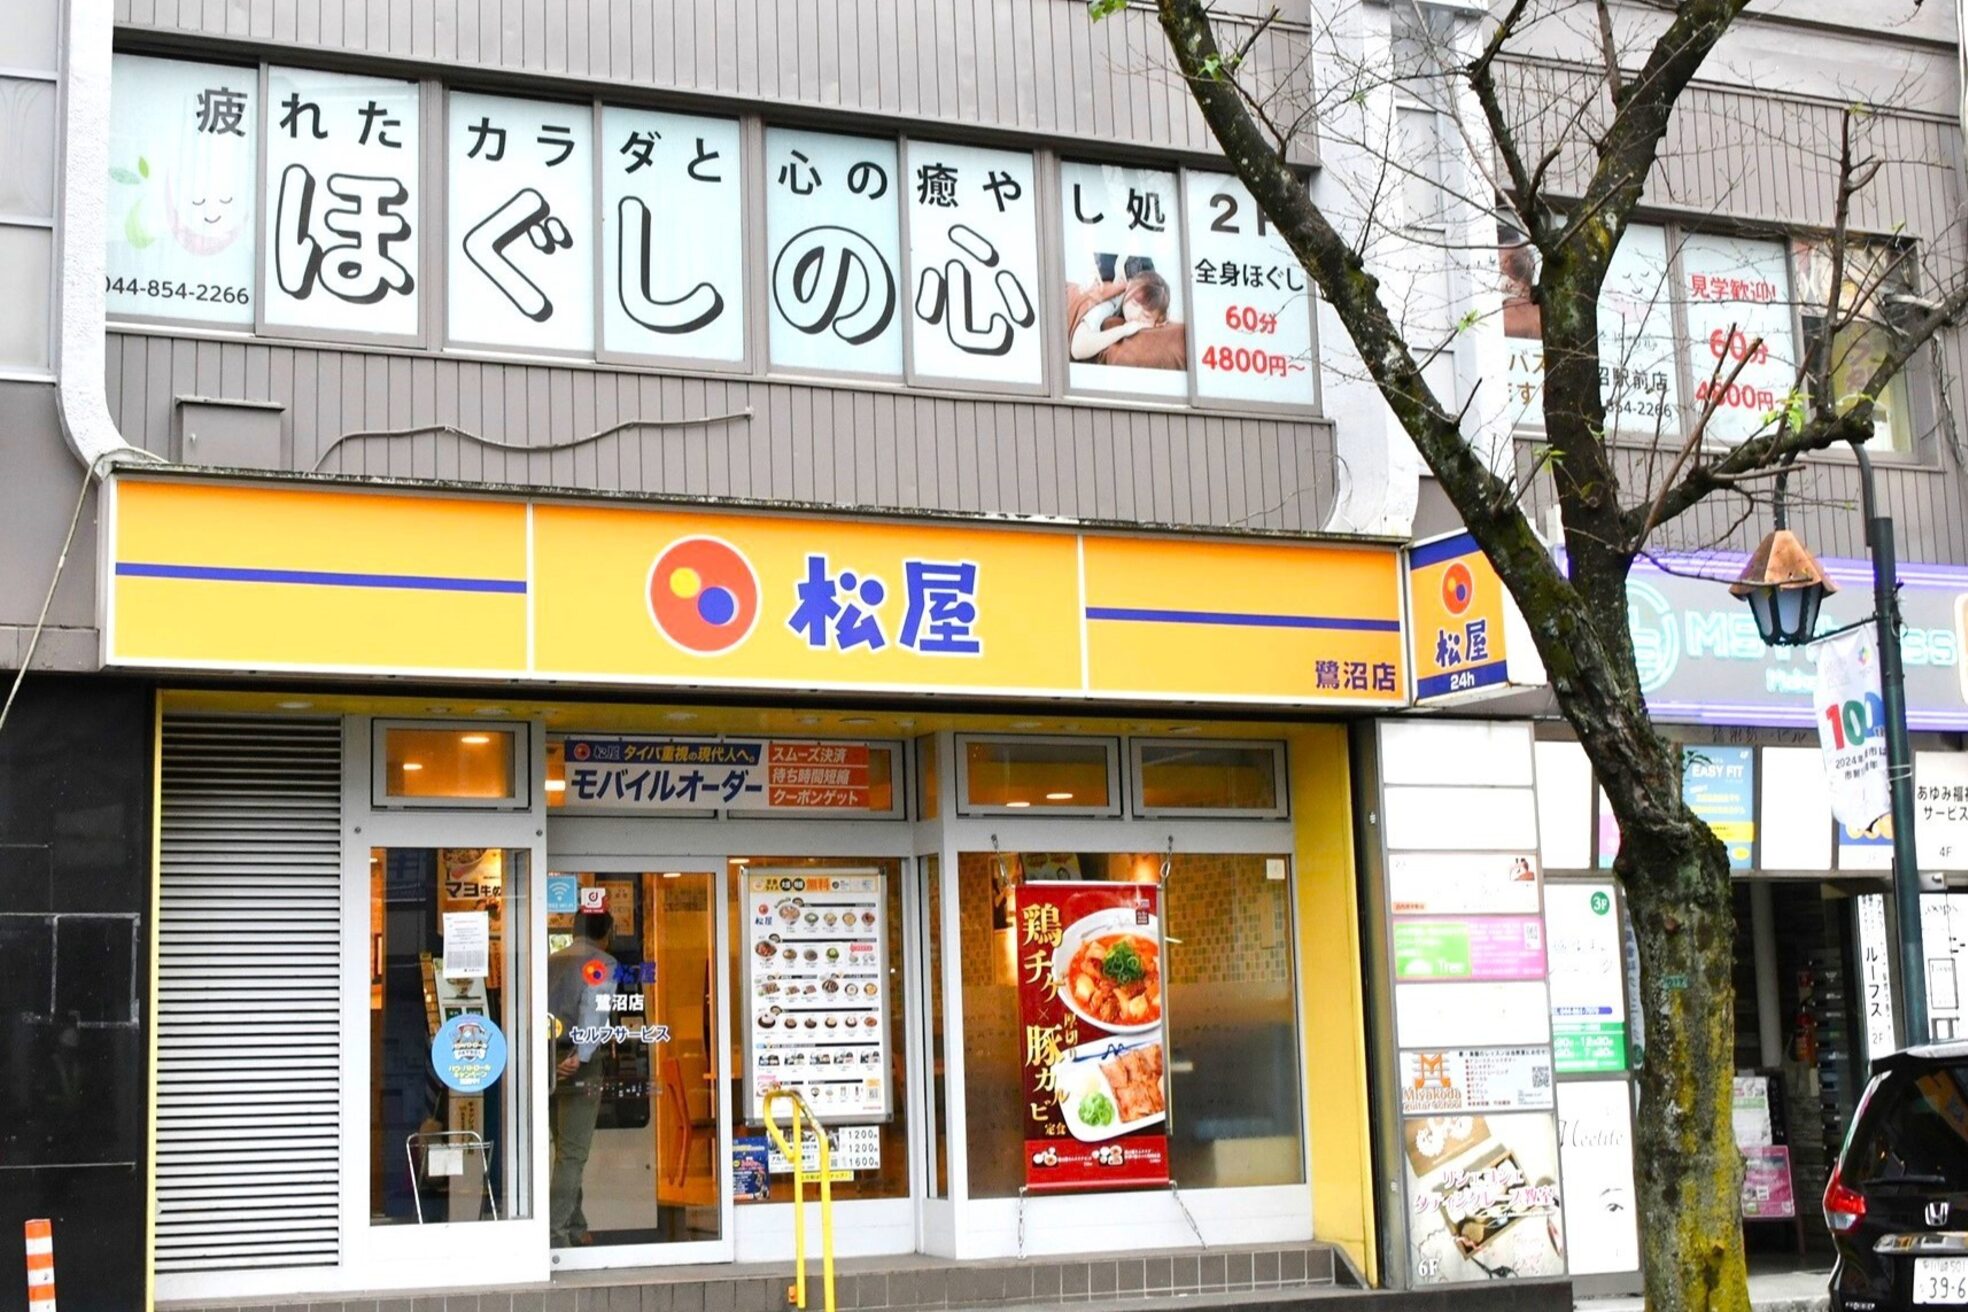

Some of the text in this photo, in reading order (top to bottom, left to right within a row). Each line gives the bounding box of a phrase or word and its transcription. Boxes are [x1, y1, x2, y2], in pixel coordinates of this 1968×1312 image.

[275, 163, 1036, 355] ほぐしの心
[1194, 258, 1304, 292] 全身ほぐし
[1225, 305, 1278, 334] 60分
[1709, 328, 1769, 365] 60分
[788, 555, 982, 655] 松屋
[1436, 620, 1489, 669] 松屋
[1314, 660, 1396, 691] 鷺沼店
[1449, 671, 1476, 691] 24h
[771, 746, 847, 762] スムーズ決済
[571, 769, 762, 802] モバイルオーダー
[772, 767, 849, 785] 待ち時間短縮
[1691, 764, 1744, 778] EASY FIT
[772, 789, 859, 805] クーポンゲット
[1924, 806, 1968, 821] サービス
[1866, 947, 1882, 1017] ルーフス
[569, 1024, 671, 1043] セルフサービス
[1418, 1258, 1439, 1276] 6F
